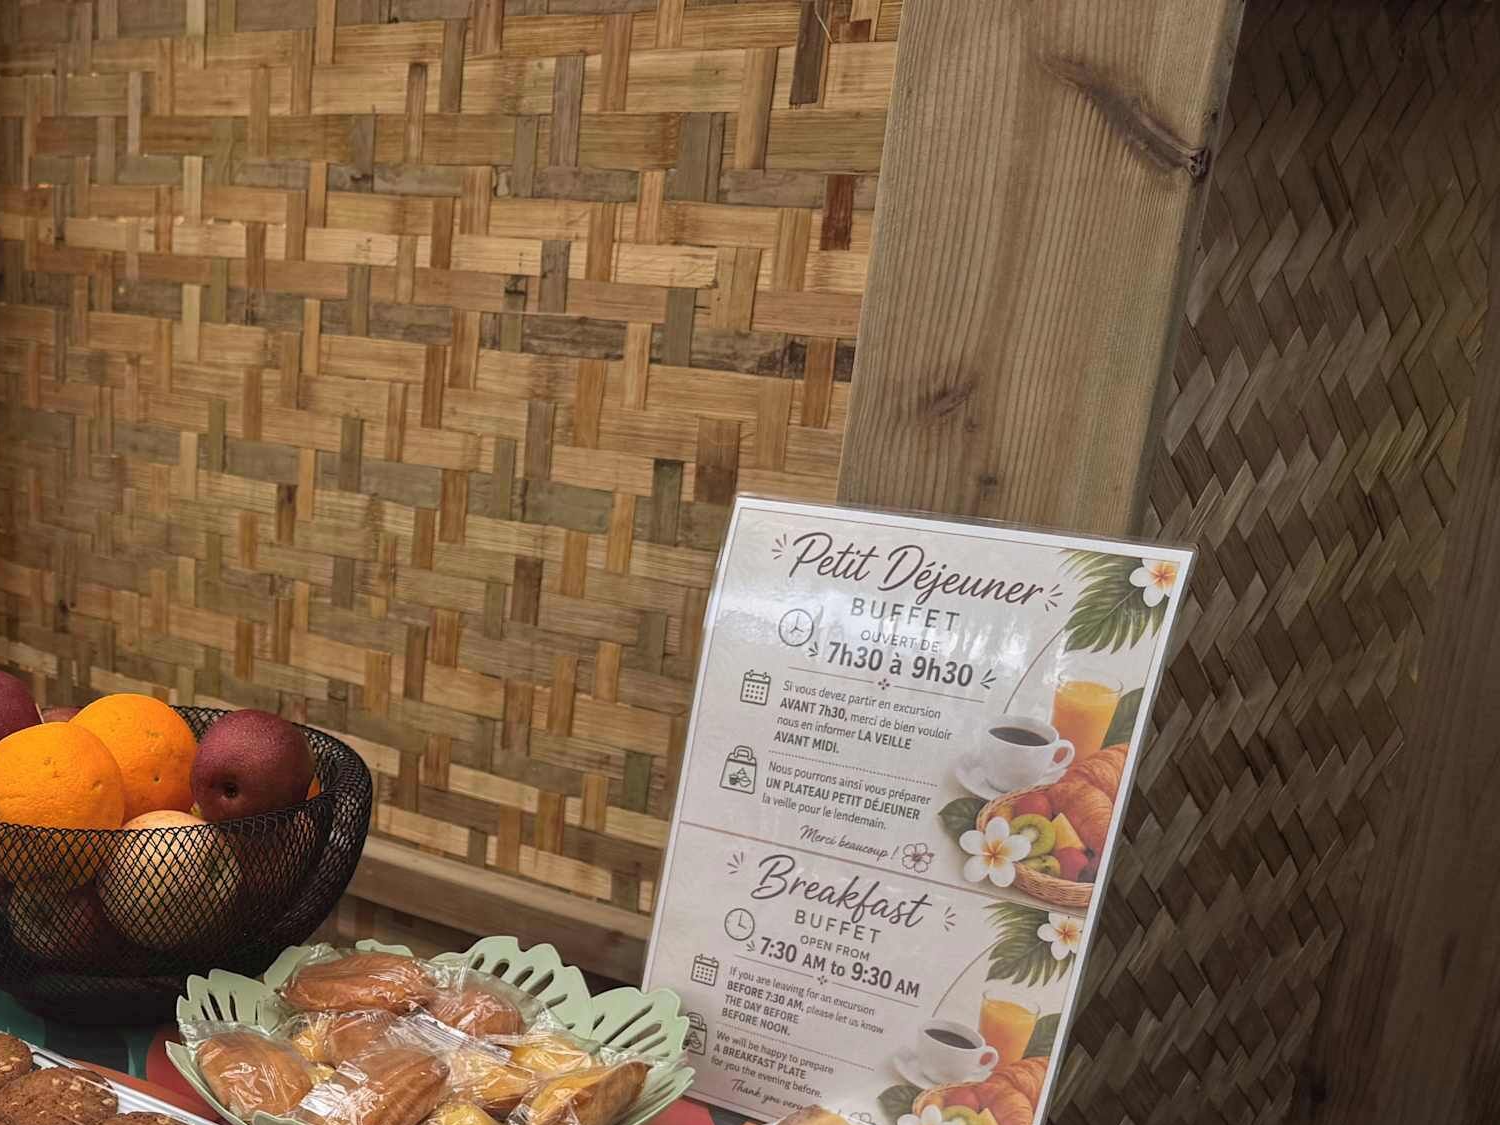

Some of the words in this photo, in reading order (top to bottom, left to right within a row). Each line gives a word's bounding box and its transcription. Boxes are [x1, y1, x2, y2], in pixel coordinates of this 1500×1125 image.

[789, 532, 879, 581] Petit
[878, 545, 1044, 605] Déjeuner
[851, 597, 960, 631] BUFFET
[861, 630, 917, 649] OUVERT
[920, 639, 940, 654] DE
[827, 641, 883, 671] 7h30
[889, 652, 902, 676] à
[911, 655, 973, 687] 9h30
[780, 697, 816, 714] AVANT
[818, 704, 848, 722] 7h30,
[850, 713, 877, 726] merci
[879, 717, 892, 729] de
[893, 719, 916, 733] bien
[917, 726, 953, 740] vouloir
[783, 680, 793, 692] Si
[795, 685, 817, 696] vous
[819, 687, 846, 702] devez
[848, 693, 877, 707] partir
[878, 700, 891, 710] en
[893, 703, 941, 720] excursion
[773, 730, 811, 747] AVANT
[811, 738, 840, 754] MIDI.
[776, 716, 799, 728] nous
[800, 721, 813, 731] en
[814, 721, 857, 738] informer
[857, 729, 872, 742] LA
[875, 732, 912, 750] VEILLE
[765, 777, 781, 790] UN
[783, 780, 830, 800] PLATEAU
[831, 791, 863, 807] PETIT
[864, 797, 920, 820] DÉJEUNER
[768, 761, 793, 775] Nous
[794, 768, 837, 785] pourrons
[838, 777, 863, 790] ainsi
[864, 783, 887, 796] vous
[888, 788, 931, 805] préparer
[762, 792, 771, 804] la
[773, 796, 797, 810] veille
[797, 802, 821, 815] pour
[822, 805, 832, 817] le
[833, 807, 887, 830] lendemain.
[800, 824, 837, 845] Merci
[837, 834, 888, 861] beaucoup
[750, 854, 933, 928] Breakfast
[794, 909, 882, 944] BUFFET
[800, 935, 832, 951] OPEN
[835, 944, 870, 962] FROM
[760, 936, 798, 963] 7:30
[802, 953, 827, 972] AM
[831, 960, 845, 977] to
[851, 962, 892, 990] 9:30
[894, 978, 921, 999] AM
[725, 994, 742, 1007] THE
[744, 1000, 762, 1013] DAY
[763, 1006, 800, 1024] BEFORE
[727, 980, 764, 999] BEFORE
[765, 991, 785, 1005] 7:30
[738, 971, 754, 982] you
[755, 976, 771, 986] are
[772, 978, 805, 998] leaving
[806, 987, 820, 1000] for
[820, 994, 832, 1004] an
[833, 998, 875, 1016] excursion
[722, 1007, 758, 1026] BEFORE
[760, 1018, 791, 1036] NOON.
[713, 1043, 721, 1054] A
[722, 1045, 776, 1069] BREAKFAST
[777, 1062, 807, 1080] PLATE
[716, 1030, 730, 1042] We
[789, 1053, 798, 1063] to
[731, 1078, 762, 1098] Thank
